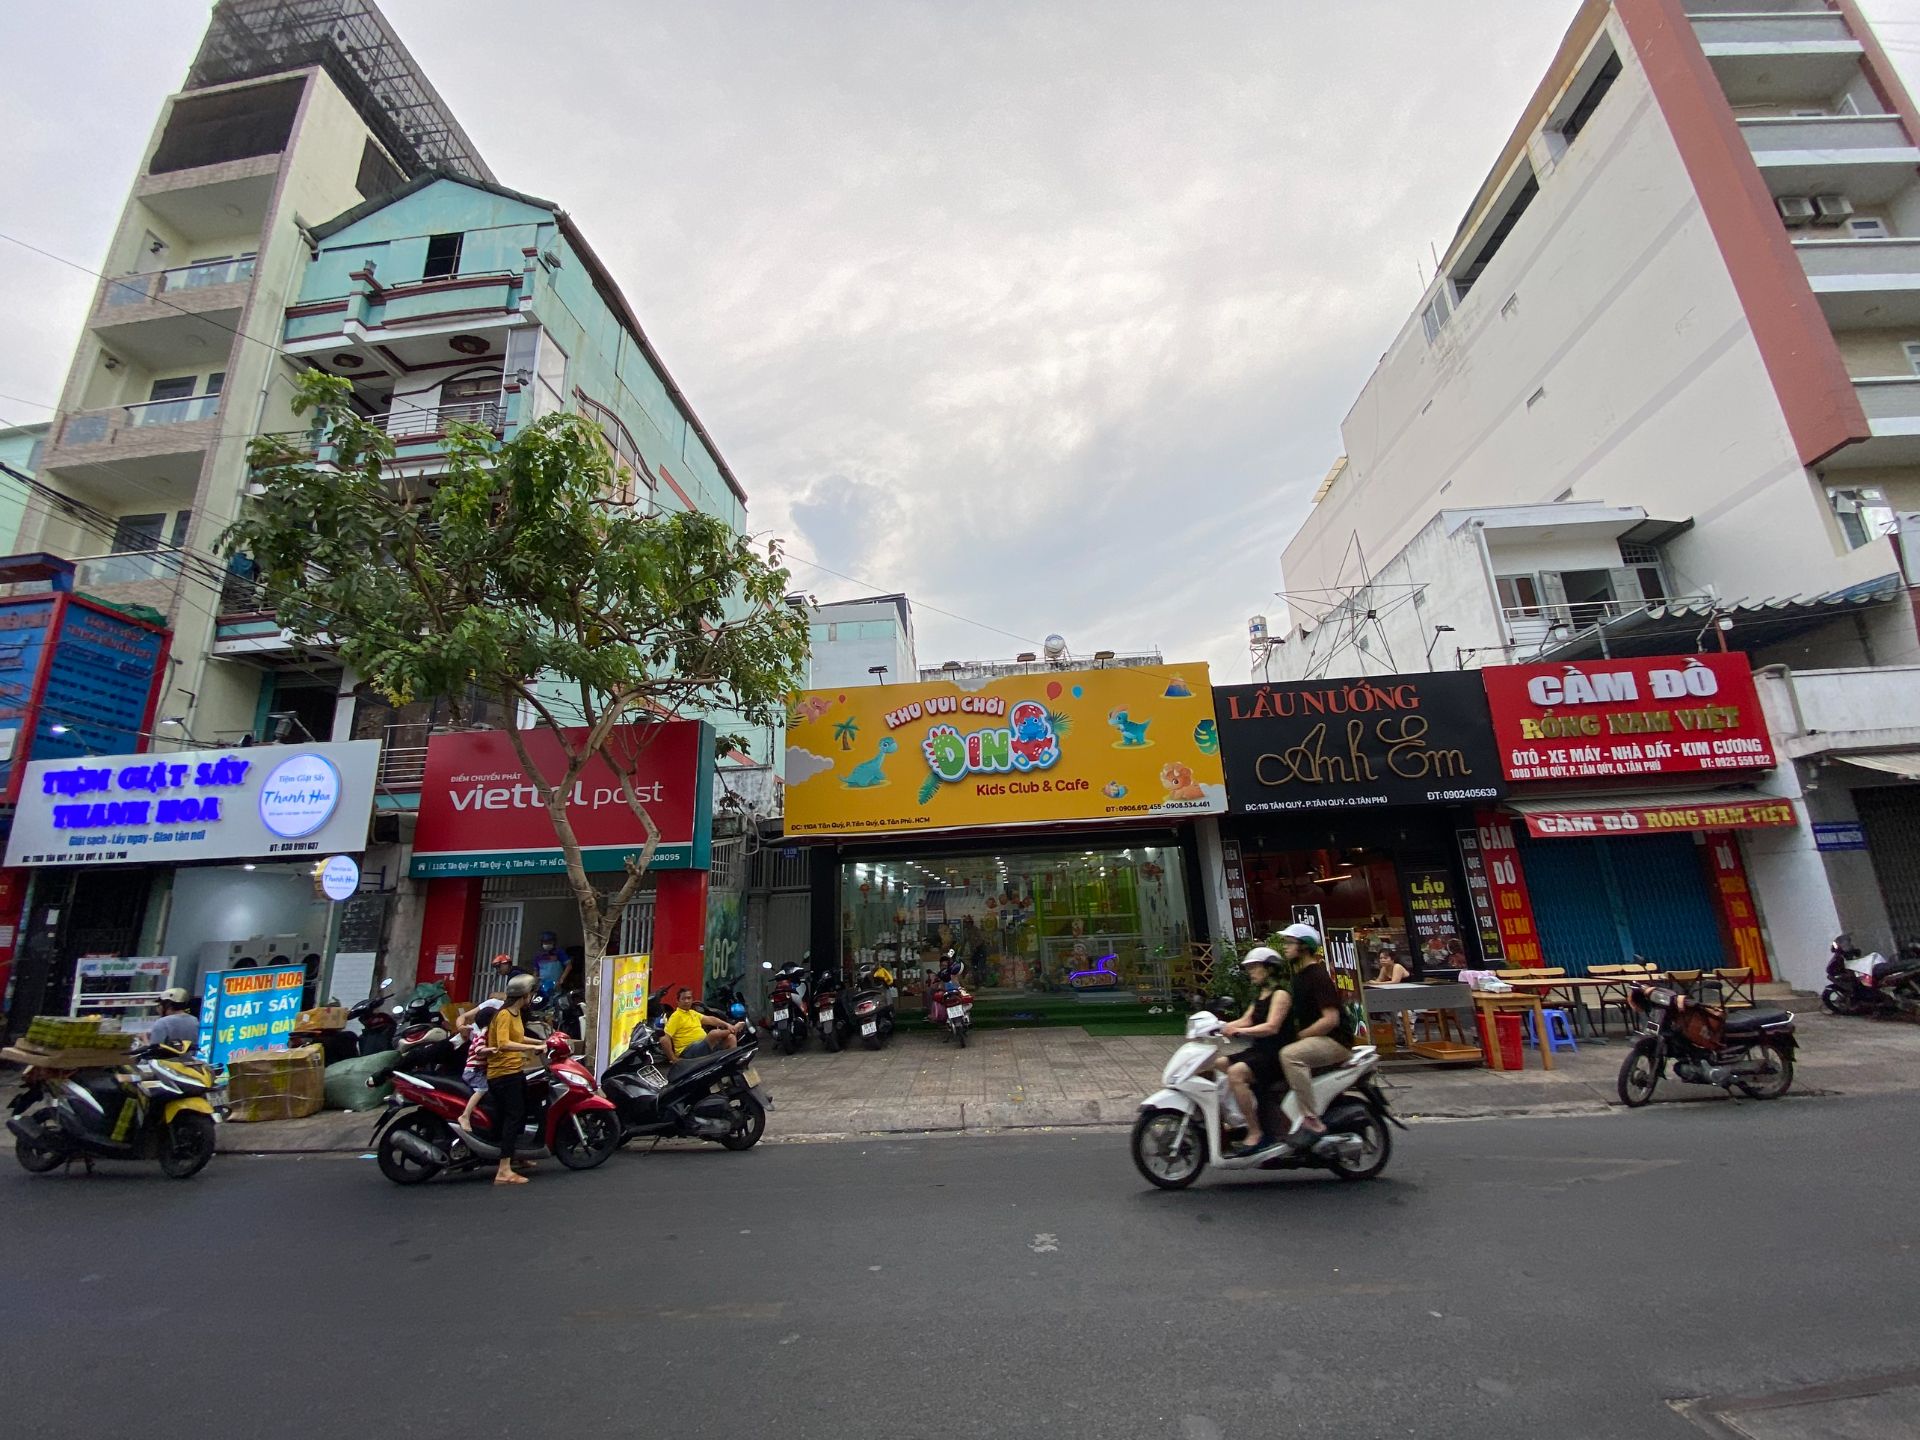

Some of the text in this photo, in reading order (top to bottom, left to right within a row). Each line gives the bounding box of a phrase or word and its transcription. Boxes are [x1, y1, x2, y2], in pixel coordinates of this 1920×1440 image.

[1528, 658, 1718, 706] CẦM ĐỒ
[885, 696, 1005, 729] KHU VUI CHƠI
[1227, 680, 1421, 720] LẨU NƯỚNG
[1520, 704, 1739, 739] RỒNG NAM VIỆT
[1255, 715, 1472, 786] Anh Em
[1512, 749, 1539, 766] ÔTÔ
[1548, 750, 1568, 764] XE
[1570, 745, 1601, 762] MÁY
[1610, 742, 1643, 760] NHÀ
[1645, 740, 1671, 758] ĐẤT
[1681, 742, 1711, 757] KIM
[1713, 738, 1762, 755] CƯƠNG
[450, 772, 521, 783] ĐIỂM CHUYỂN PHÁT
[1531, 766, 1549, 777] TÂN
[264, 789, 330, 805] Thanh Hoa
[976, 778, 1089, 797] Kids Club & Cafe
[1537, 804, 1791, 833] CẦM ĐỒ RỒNG NAM VIỆT
[1411, 875, 1445, 894] LẨU
[224, 972, 303, 996] THANH HOA
[224, 993, 299, 1018] GIẶT SẤY
[218, 1025, 235, 1045] VỆ
[239, 1023, 268, 1040] SINH
